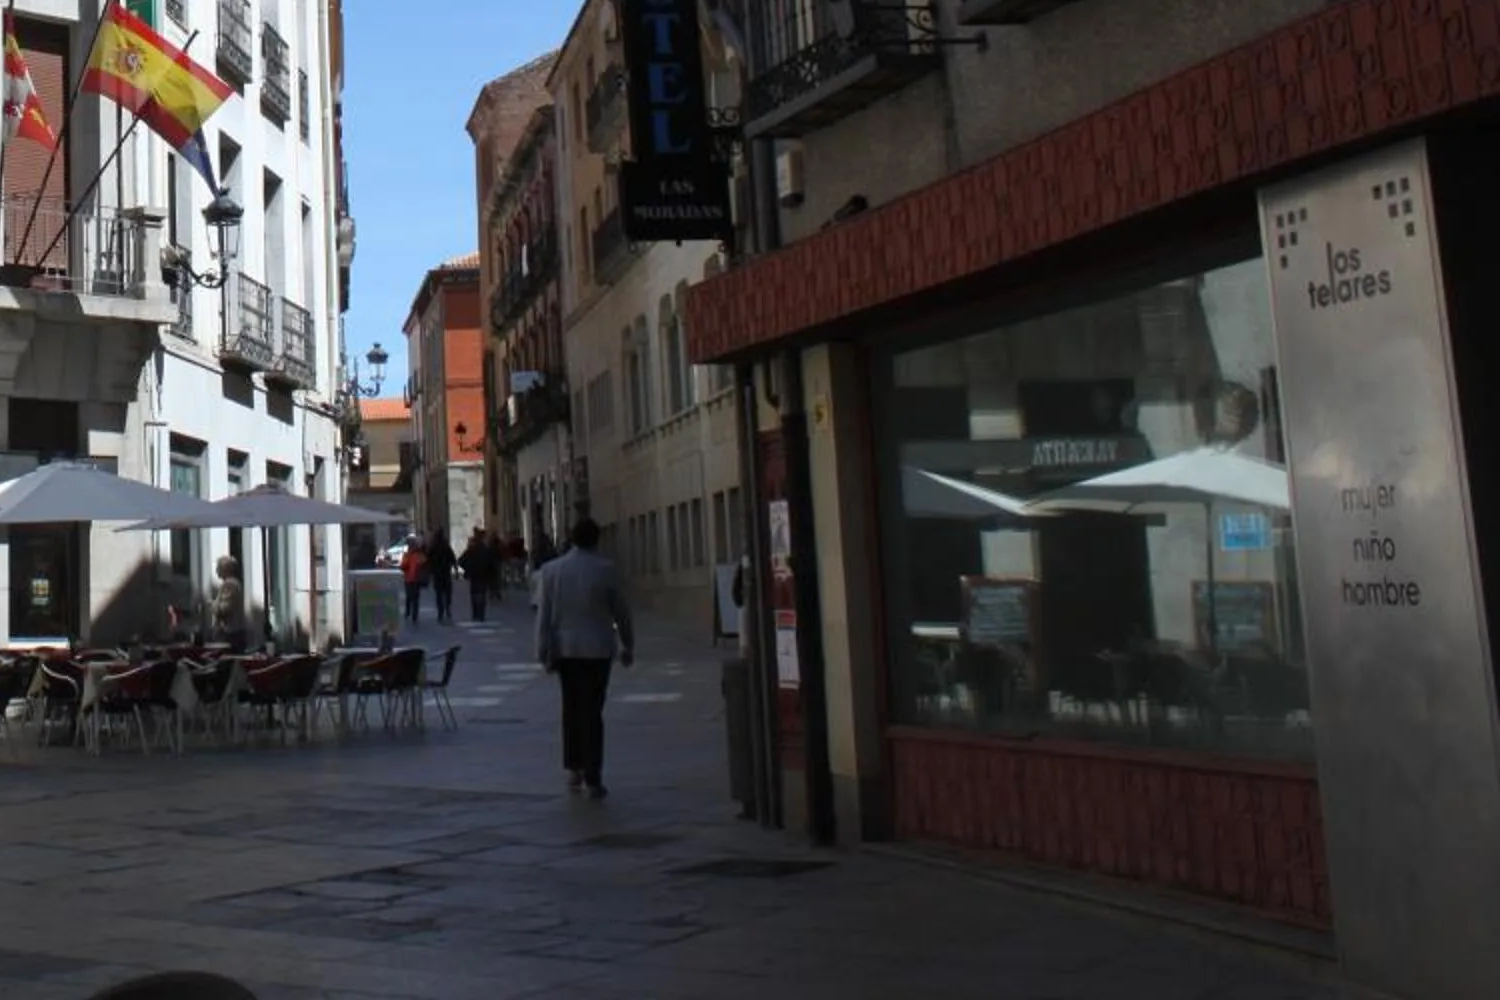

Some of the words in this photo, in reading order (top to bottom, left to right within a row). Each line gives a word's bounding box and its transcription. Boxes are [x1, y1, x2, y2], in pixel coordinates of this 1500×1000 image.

[659, 180, 695, 194] LAS
[633, 204, 723, 219] MORADAS
[1326, 241, 1361, 280] los
[1308, 269, 1391, 309] telares
[1342, 484, 1396, 518] mujer
[1353, 529, 1395, 562] niño
[1341, 575, 1420, 606] hombre
